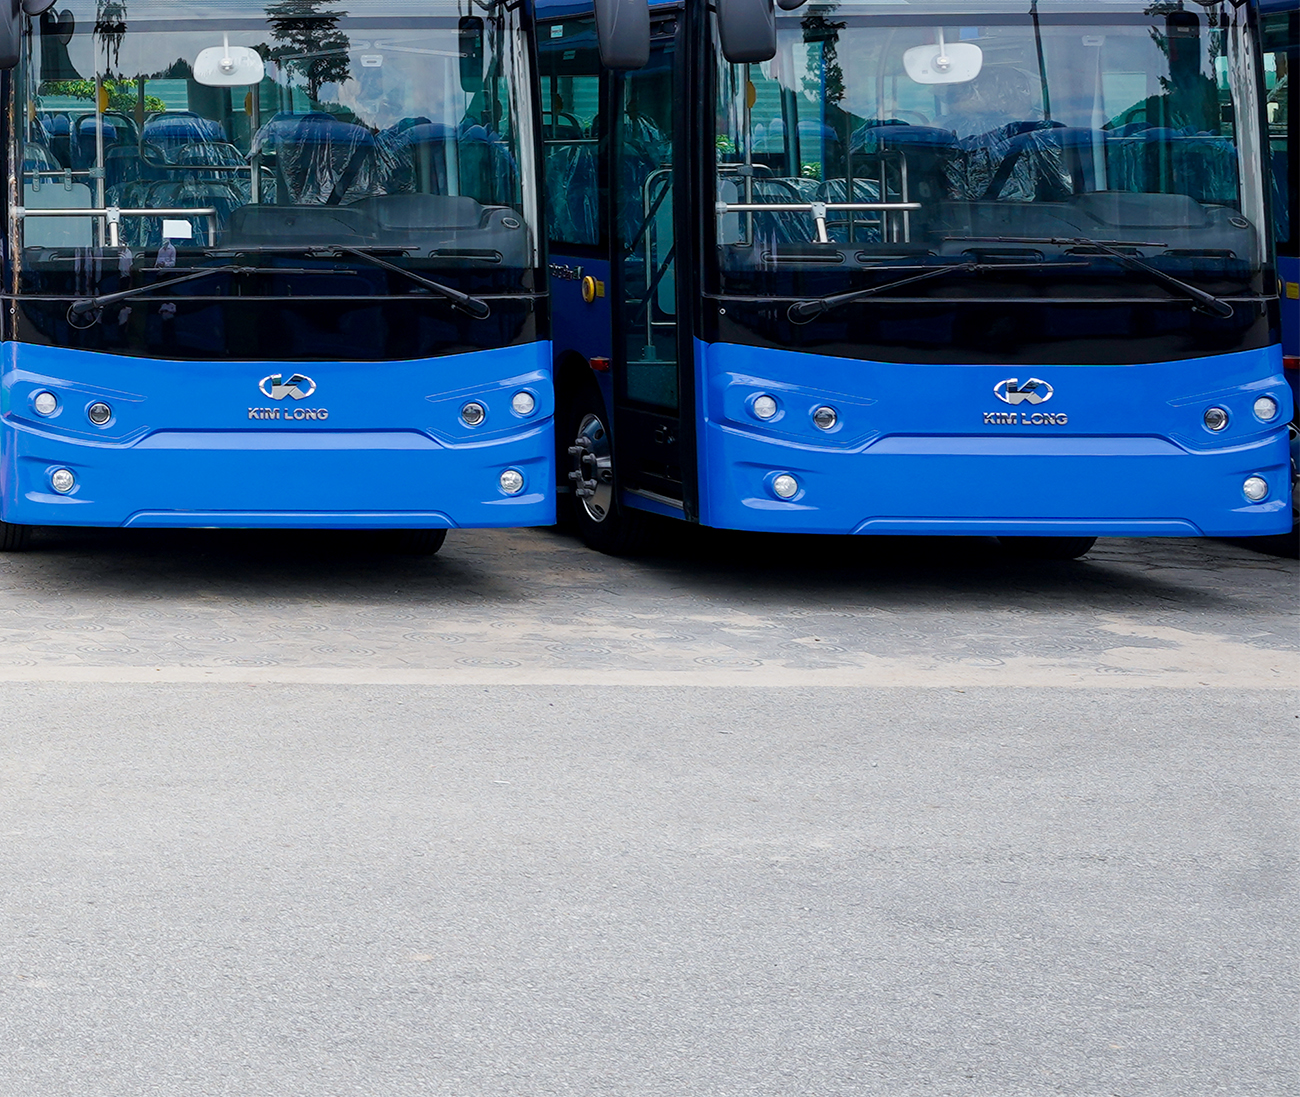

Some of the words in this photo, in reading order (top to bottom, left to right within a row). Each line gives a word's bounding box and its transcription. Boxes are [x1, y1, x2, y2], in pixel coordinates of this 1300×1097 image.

[248, 407, 280, 420] KIM
[284, 407, 329, 420] LONG
[983, 412, 1018, 425] KIM
[1021, 412, 1068, 425] LONG
